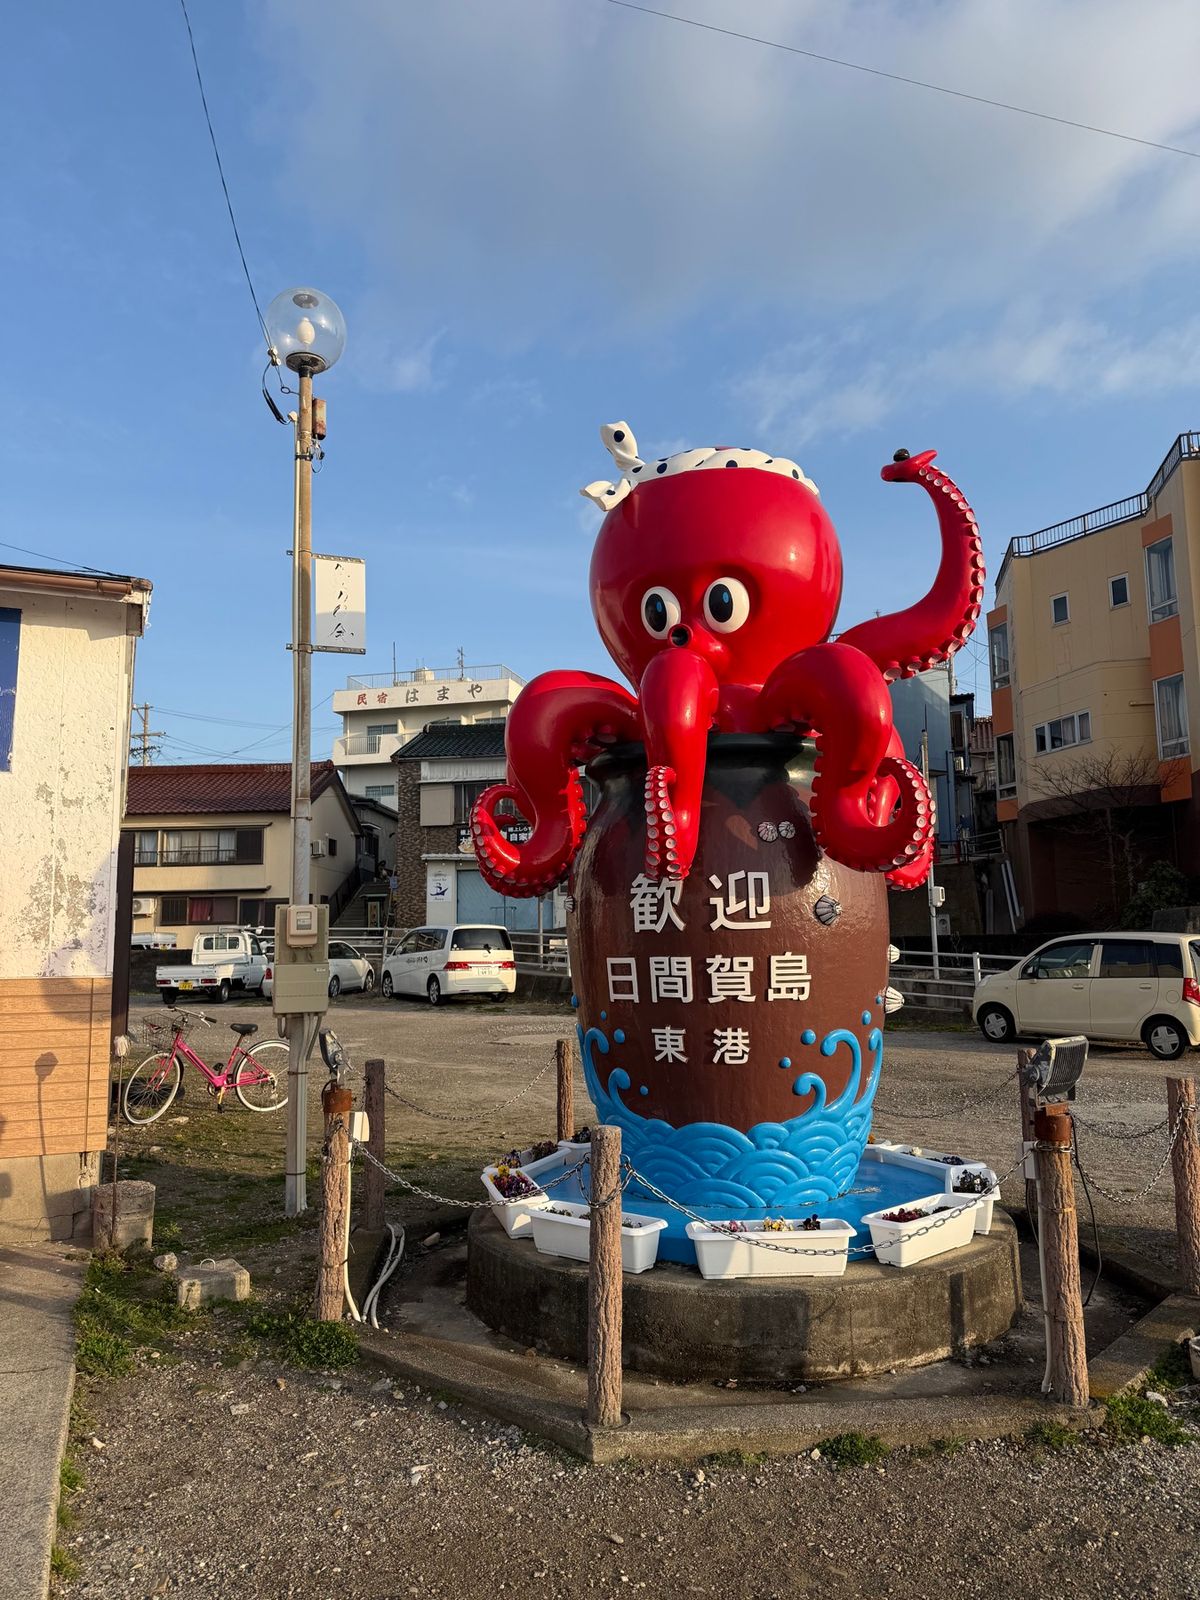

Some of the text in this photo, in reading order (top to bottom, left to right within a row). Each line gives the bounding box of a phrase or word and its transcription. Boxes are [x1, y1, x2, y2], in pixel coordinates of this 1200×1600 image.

[357, 683, 483, 706] 民宿 はまや
[629, 870, 771, 933] 歓迎
[606, 952, 812, 1003] 日間賀島
[651, 1025, 751, 1065] 東港
